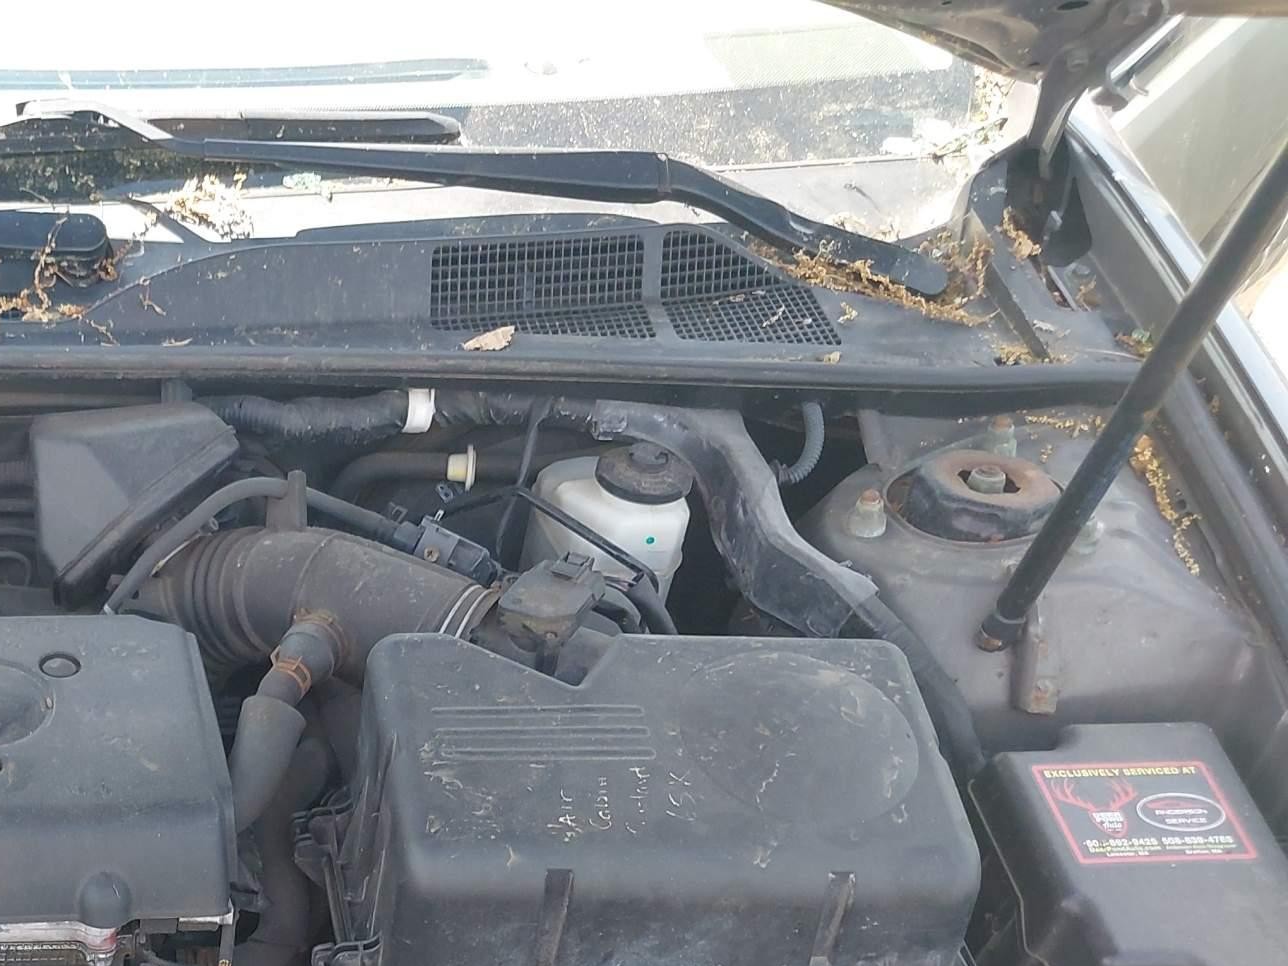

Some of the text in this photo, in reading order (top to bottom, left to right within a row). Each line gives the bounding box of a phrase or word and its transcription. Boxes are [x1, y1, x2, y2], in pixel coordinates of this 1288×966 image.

[1043, 766, 1197, 779] EXCLUSIVELY SERVICED AT
